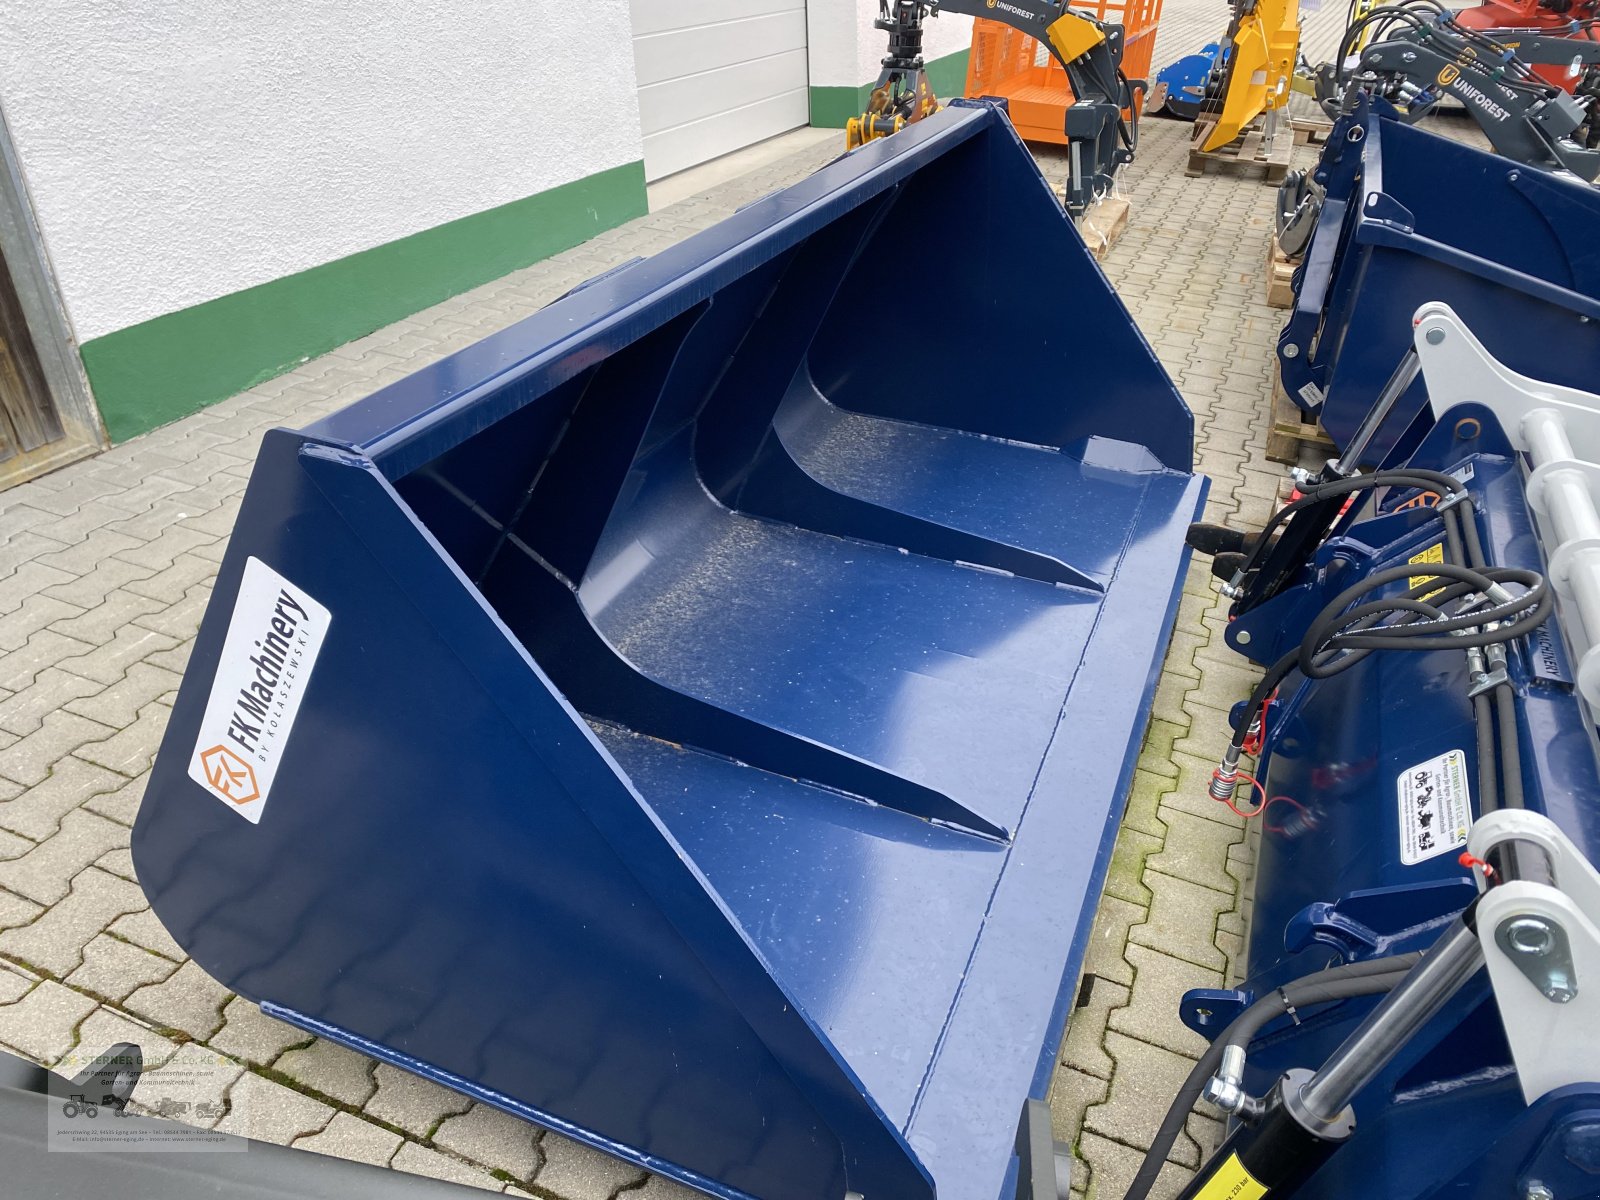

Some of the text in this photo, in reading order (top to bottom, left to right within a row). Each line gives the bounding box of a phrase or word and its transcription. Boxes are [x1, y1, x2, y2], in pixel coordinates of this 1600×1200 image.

[996, 1, 1035, 20] UNIFOREST
[1453, 77, 1512, 121] UNIFOREST
[1536, 628, 1561, 677] MACHINERY
[227, 588, 309, 753] FK Machinery
[258, 746, 270, 762] BY
[1451, 765, 1460, 790] STERNER
[1232, 1185, 1242, 1196] 230
[1240, 1177, 1249, 1187] bar
